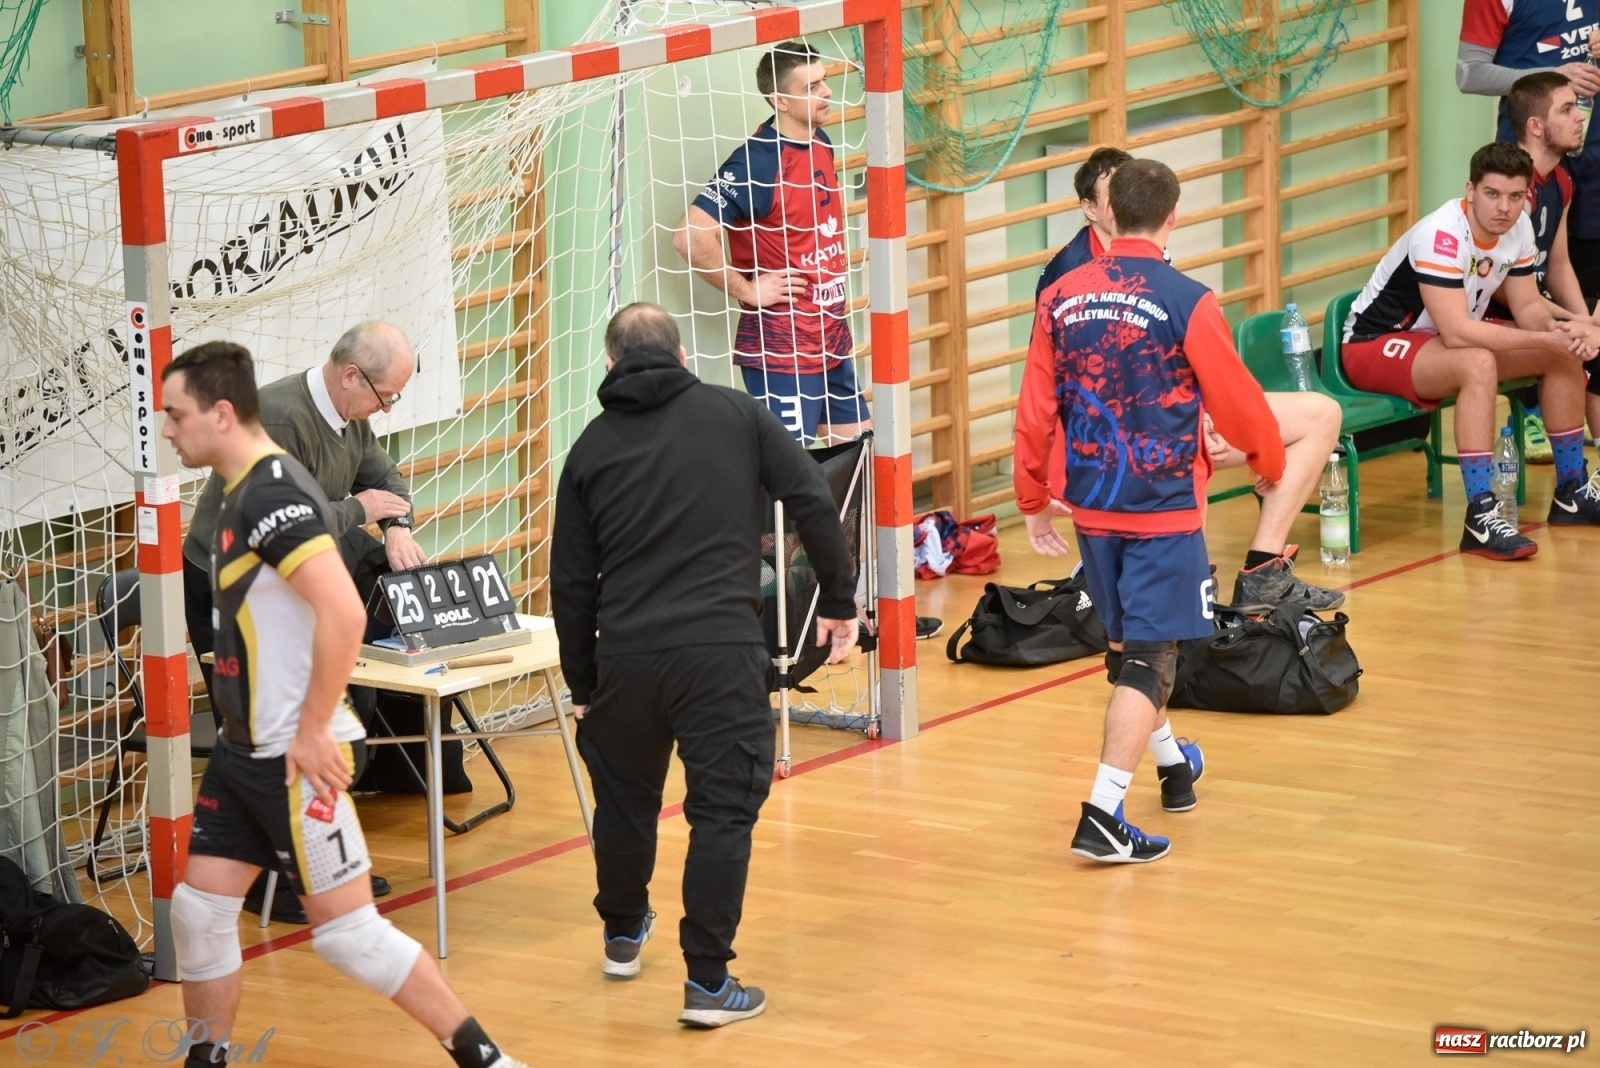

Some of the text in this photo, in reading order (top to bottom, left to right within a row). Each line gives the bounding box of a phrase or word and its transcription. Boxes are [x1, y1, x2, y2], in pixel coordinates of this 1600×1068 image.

[222, 120, 256, 141] sport
[1063, 308, 1149, 329] VOLLEYBALL TEAM
[1100, 292, 1138, 306] KATOLIK
[1137, 298, 1169, 322] GROUP
[137, 390, 149, 469] sport
[779, 396, 801, 432] 3
[387, 561, 509, 625] 25 2 2 21
[433, 608, 472, 626] JOOLA
[327, 828, 348, 864] 1
